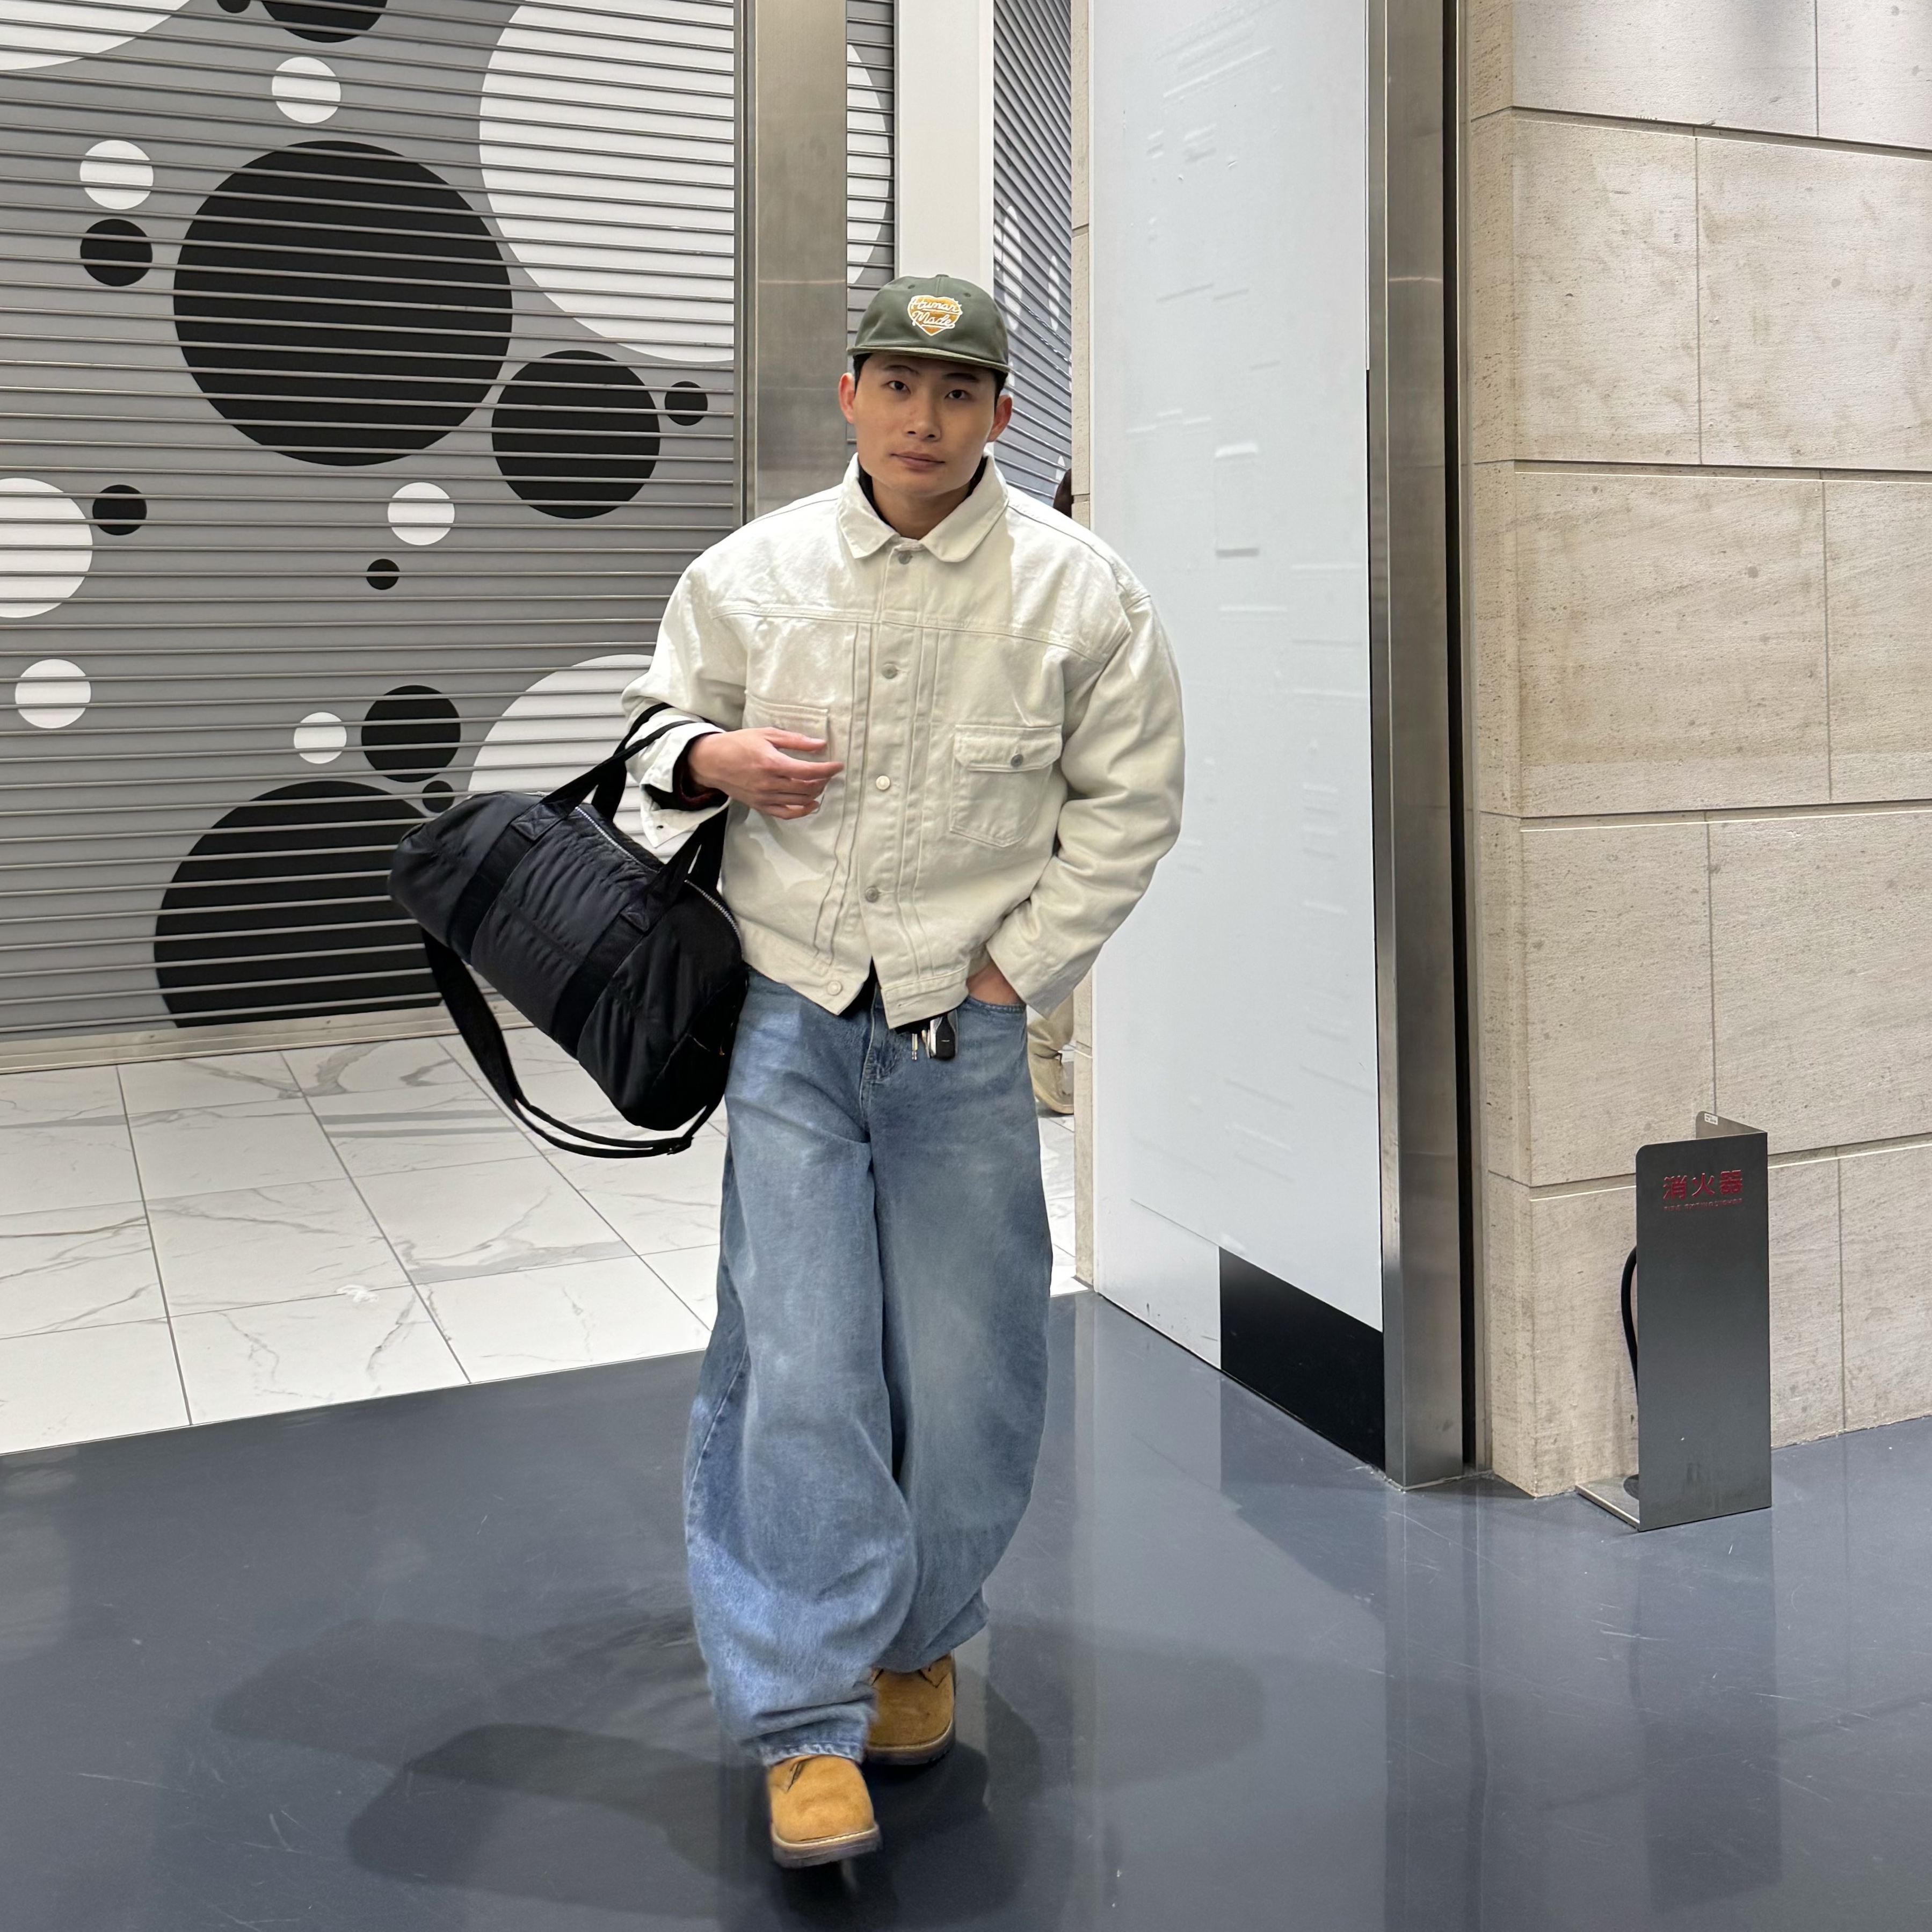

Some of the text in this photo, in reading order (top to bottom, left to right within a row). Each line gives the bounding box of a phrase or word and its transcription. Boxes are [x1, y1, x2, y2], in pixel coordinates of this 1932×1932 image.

[910, 299, 961, 314] Human
[912, 310, 953, 326] Made
[1663, 1170, 1743, 1200] 消火器
